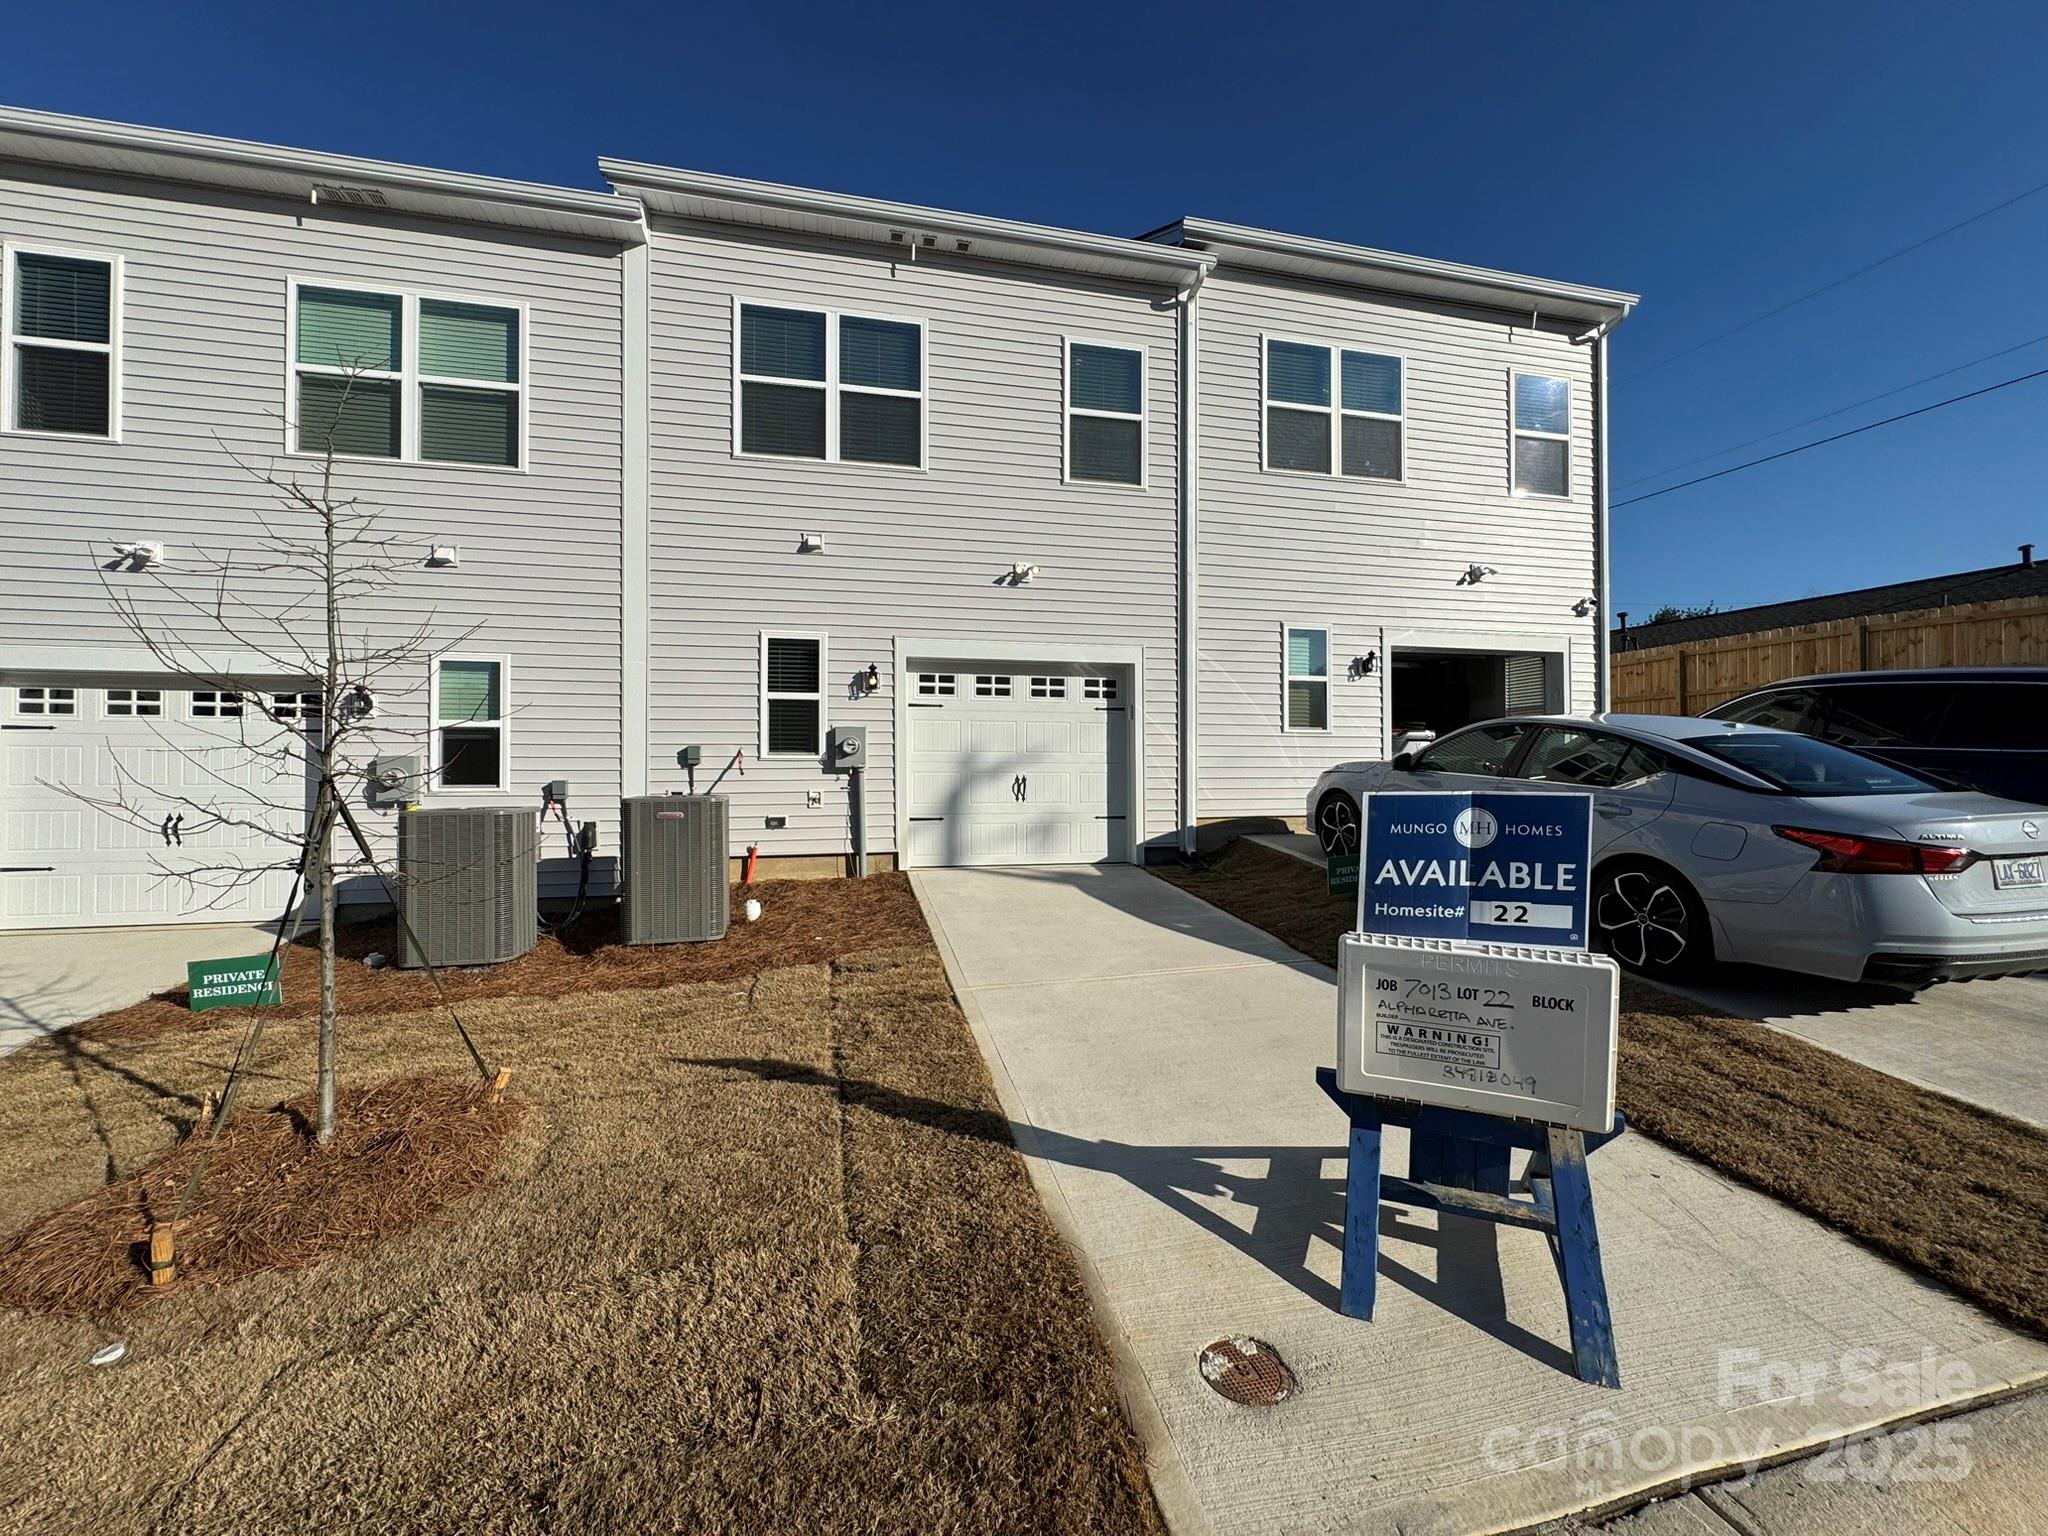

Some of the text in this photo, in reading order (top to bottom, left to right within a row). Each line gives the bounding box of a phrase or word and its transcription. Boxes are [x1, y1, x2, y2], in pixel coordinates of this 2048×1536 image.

[1390, 820, 1563, 837] MUNGO MH HOMES
[1919, 833, 1965, 841] ALTIMA
[1374, 858, 1577, 892] AVAILABLE
[1375, 903, 1529, 923] Homesite# 22
[1422, 953, 1520, 978] PERMITS
[203, 969, 266, 985] PRIVATE
[1376, 978, 1575, 1013] JOB 7013 LOT 22 BLOCK
[1376, 1012, 1399, 1020] BUILDER
[1386, 1023, 1489, 1047] WARNING!
[1403, 1036, 1437, 1046] DESIGNATED
[1438, 1040, 1481, 1052] CONSTRUCTION
[1390, 1041, 1425, 1051] TRESPASSERS
[1447, 1049, 1485, 1060] PROSECUTED
[1407, 1050, 1430, 1058] FULLEST
[1430, 1053, 1451, 1061] EXTENT
